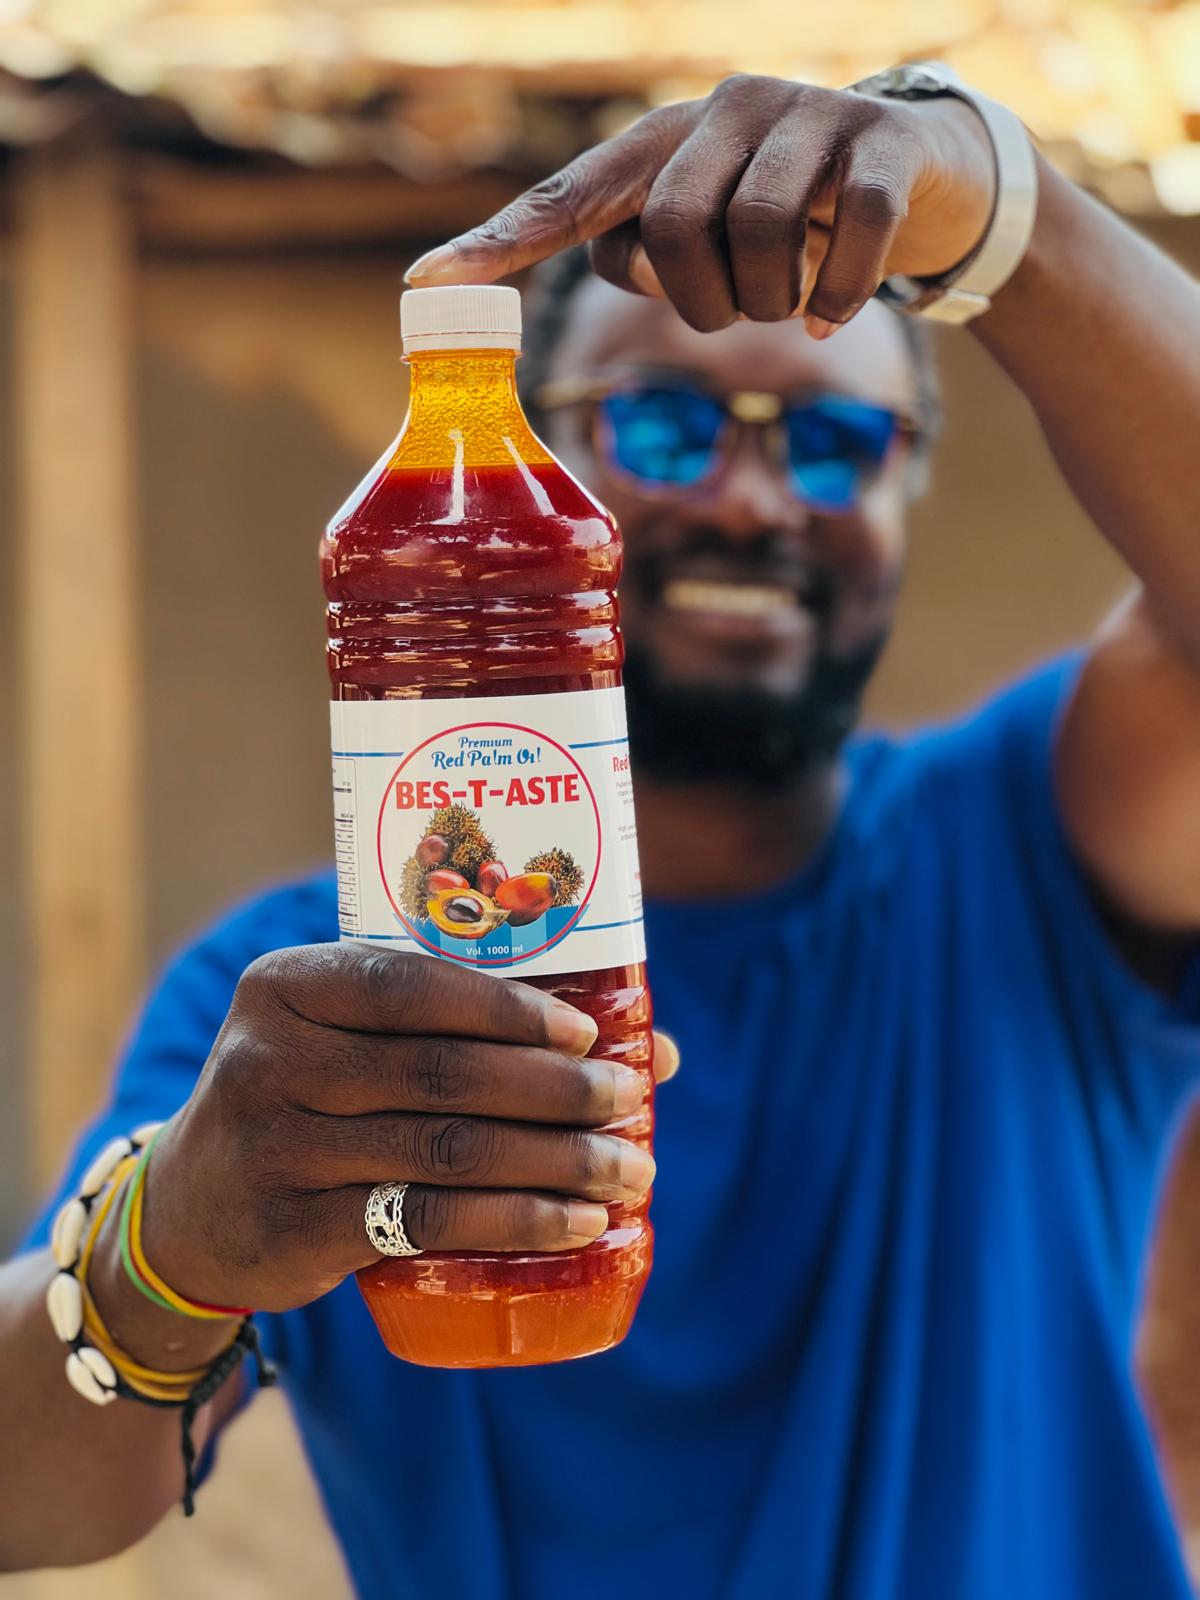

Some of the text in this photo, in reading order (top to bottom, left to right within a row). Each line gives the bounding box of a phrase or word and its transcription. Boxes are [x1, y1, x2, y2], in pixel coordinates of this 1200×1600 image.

[458, 736, 513, 748] Premium
[431, 750, 464, 769] Red
[467, 749, 512, 767] Palm
[613, 753, 628, 772] Red
[396, 774, 580, 809] BES-T-ASTE
[466, 944, 523, 956] Vol. 1000 ml
